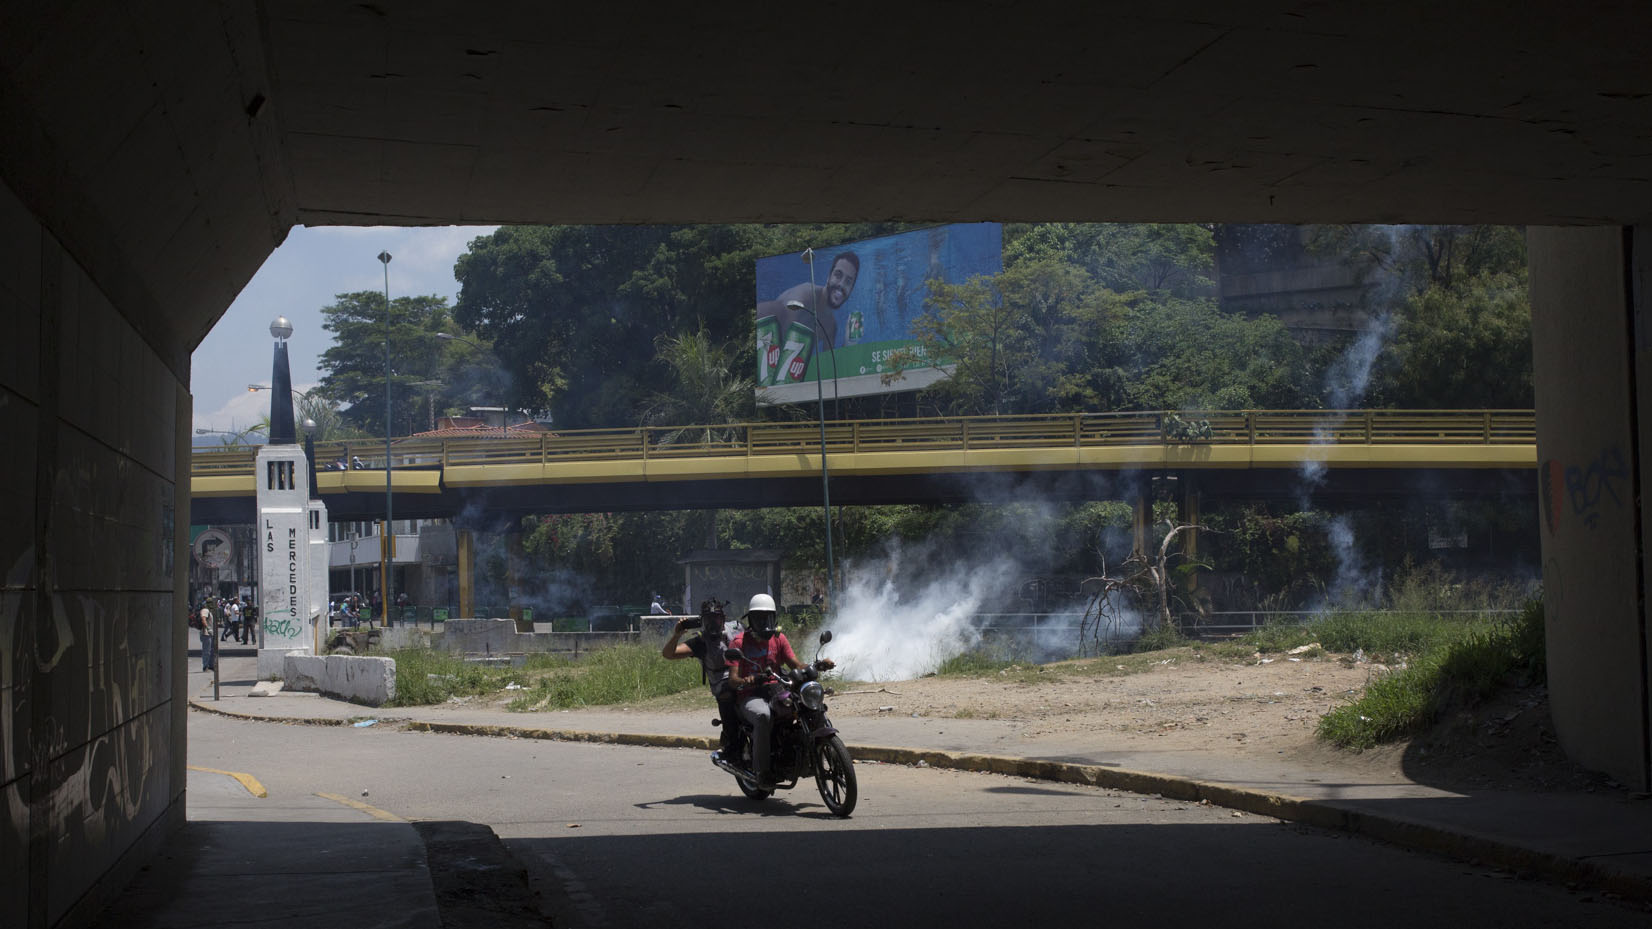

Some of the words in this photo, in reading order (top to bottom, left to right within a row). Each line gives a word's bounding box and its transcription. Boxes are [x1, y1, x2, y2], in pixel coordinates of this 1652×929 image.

[872, 351, 881, 363] SE
[266, 519, 274, 552] LAS
[288, 528, 297, 617] MERCEDES
